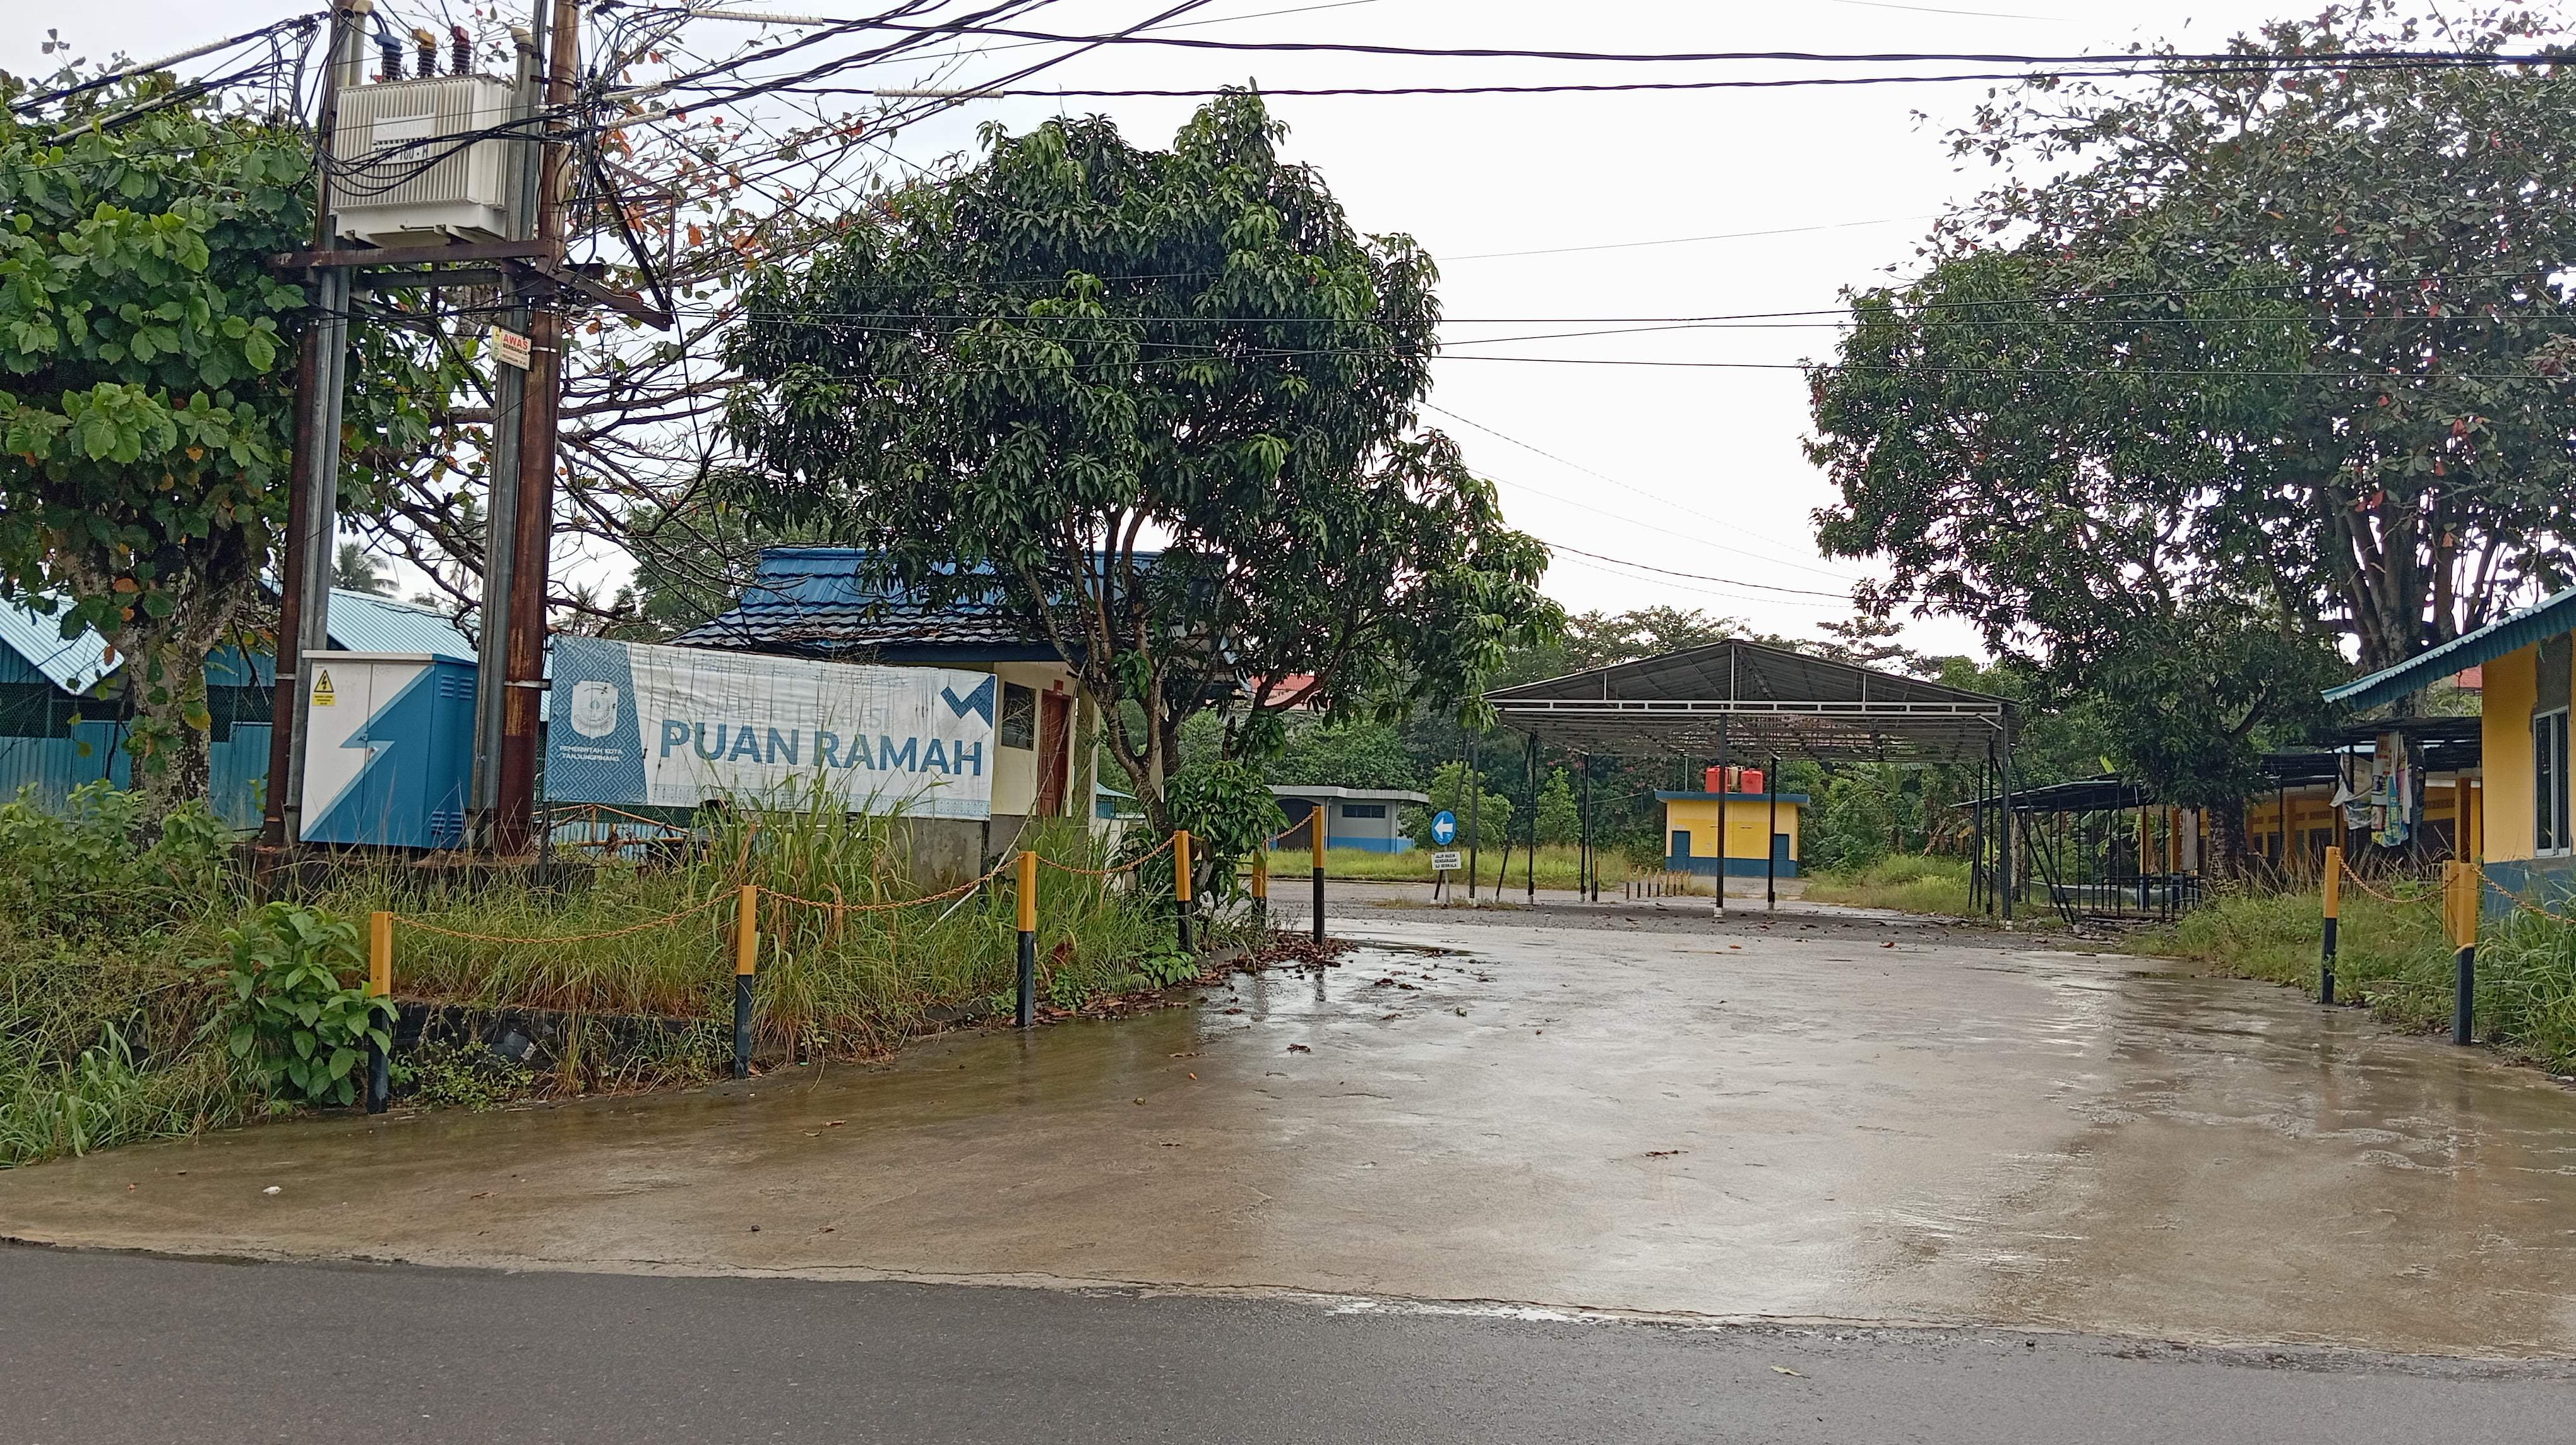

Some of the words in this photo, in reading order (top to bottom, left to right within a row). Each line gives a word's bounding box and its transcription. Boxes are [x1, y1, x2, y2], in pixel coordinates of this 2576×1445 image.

[503, 333, 528, 350] AWAS
[559, 745, 602, 755] PEMERINTAH
[660, 719, 799, 765] PUAN
[813, 731, 982, 776] RAMAH
[562, 753, 619, 762] TANJUNGPINANG
